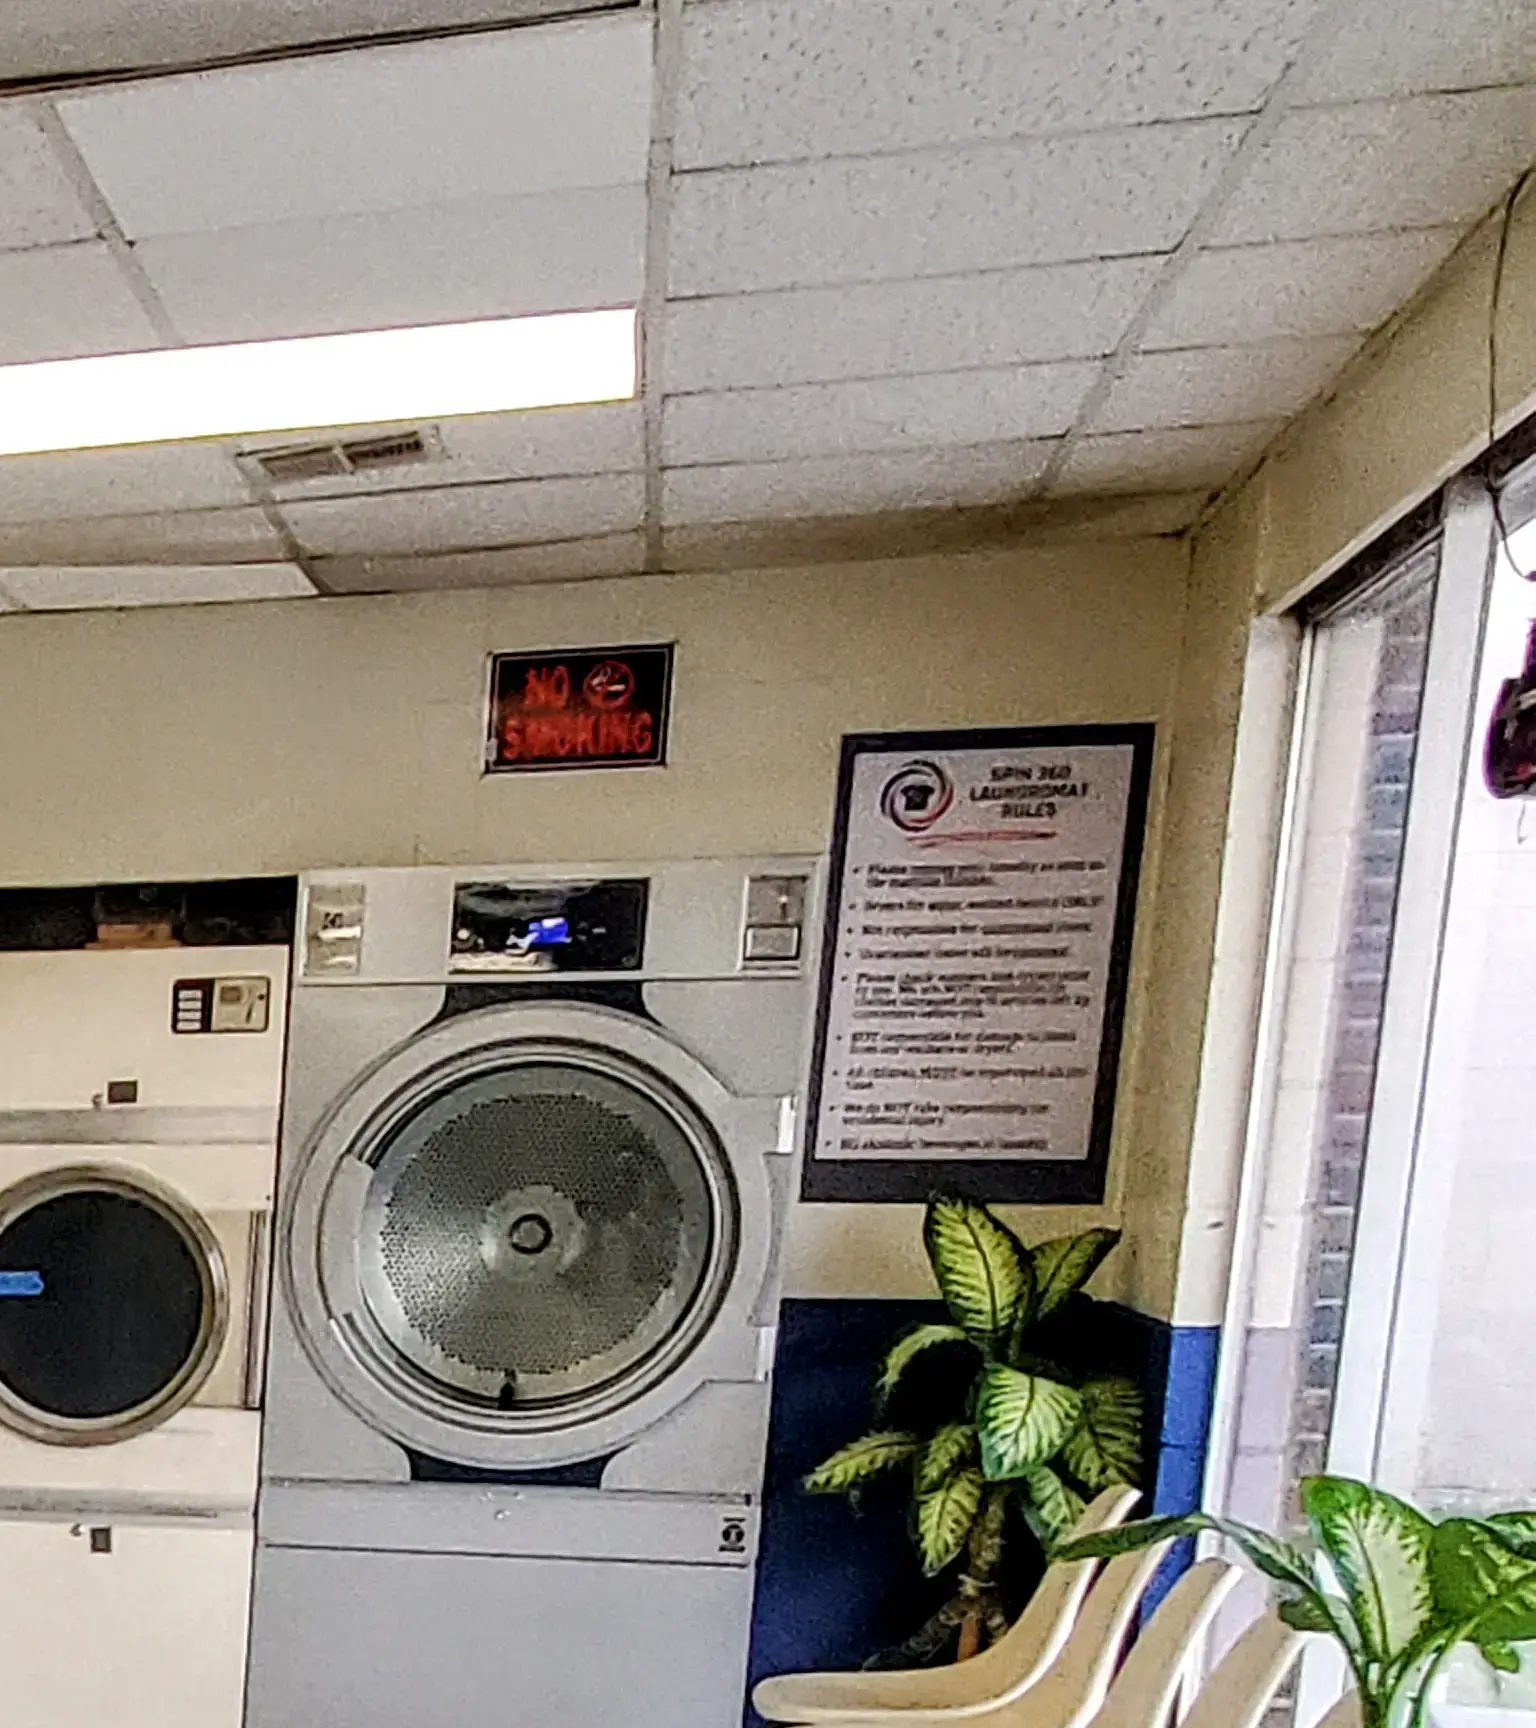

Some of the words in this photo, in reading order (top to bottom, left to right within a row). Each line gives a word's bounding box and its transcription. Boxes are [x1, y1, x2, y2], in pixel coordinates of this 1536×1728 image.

[522, 664, 570, 709] NO
[502, 709, 653, 760] SMOKING
[991, 765, 1033, 782] SPIN
[969, 781, 1090, 802] LAUNDROMAT
[1000, 801, 1058, 819] RULES
